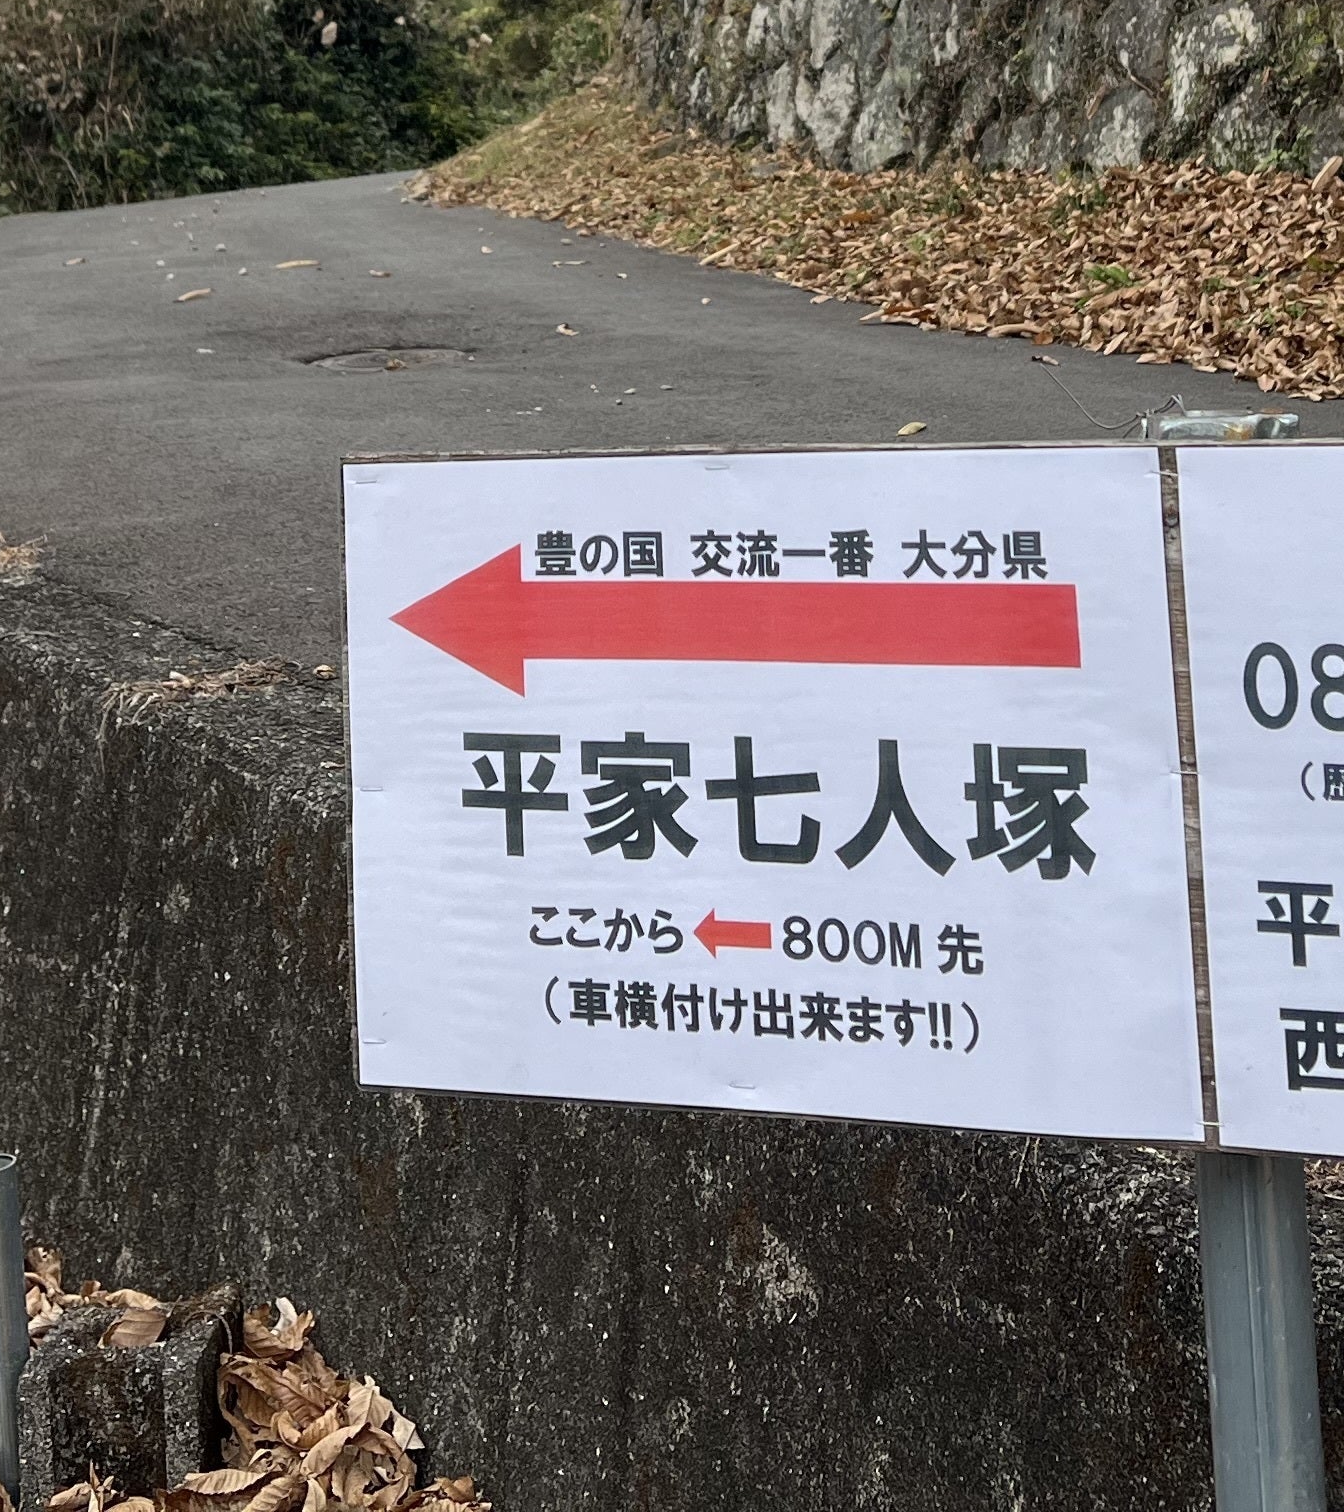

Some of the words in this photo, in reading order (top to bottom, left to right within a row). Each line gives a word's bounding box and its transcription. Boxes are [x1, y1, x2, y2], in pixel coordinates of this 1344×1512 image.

[535, 531, 663, 577] 豊の国
[691, 530, 873, 577] 交流一番
[902, 530, 1047, 579] 大分県
[462, 732, 1096, 880] 平家七人塚
[530, 907, 684, 954] ここから
[783, 916, 922, 969] 800M
[937, 923, 984, 974] 先
